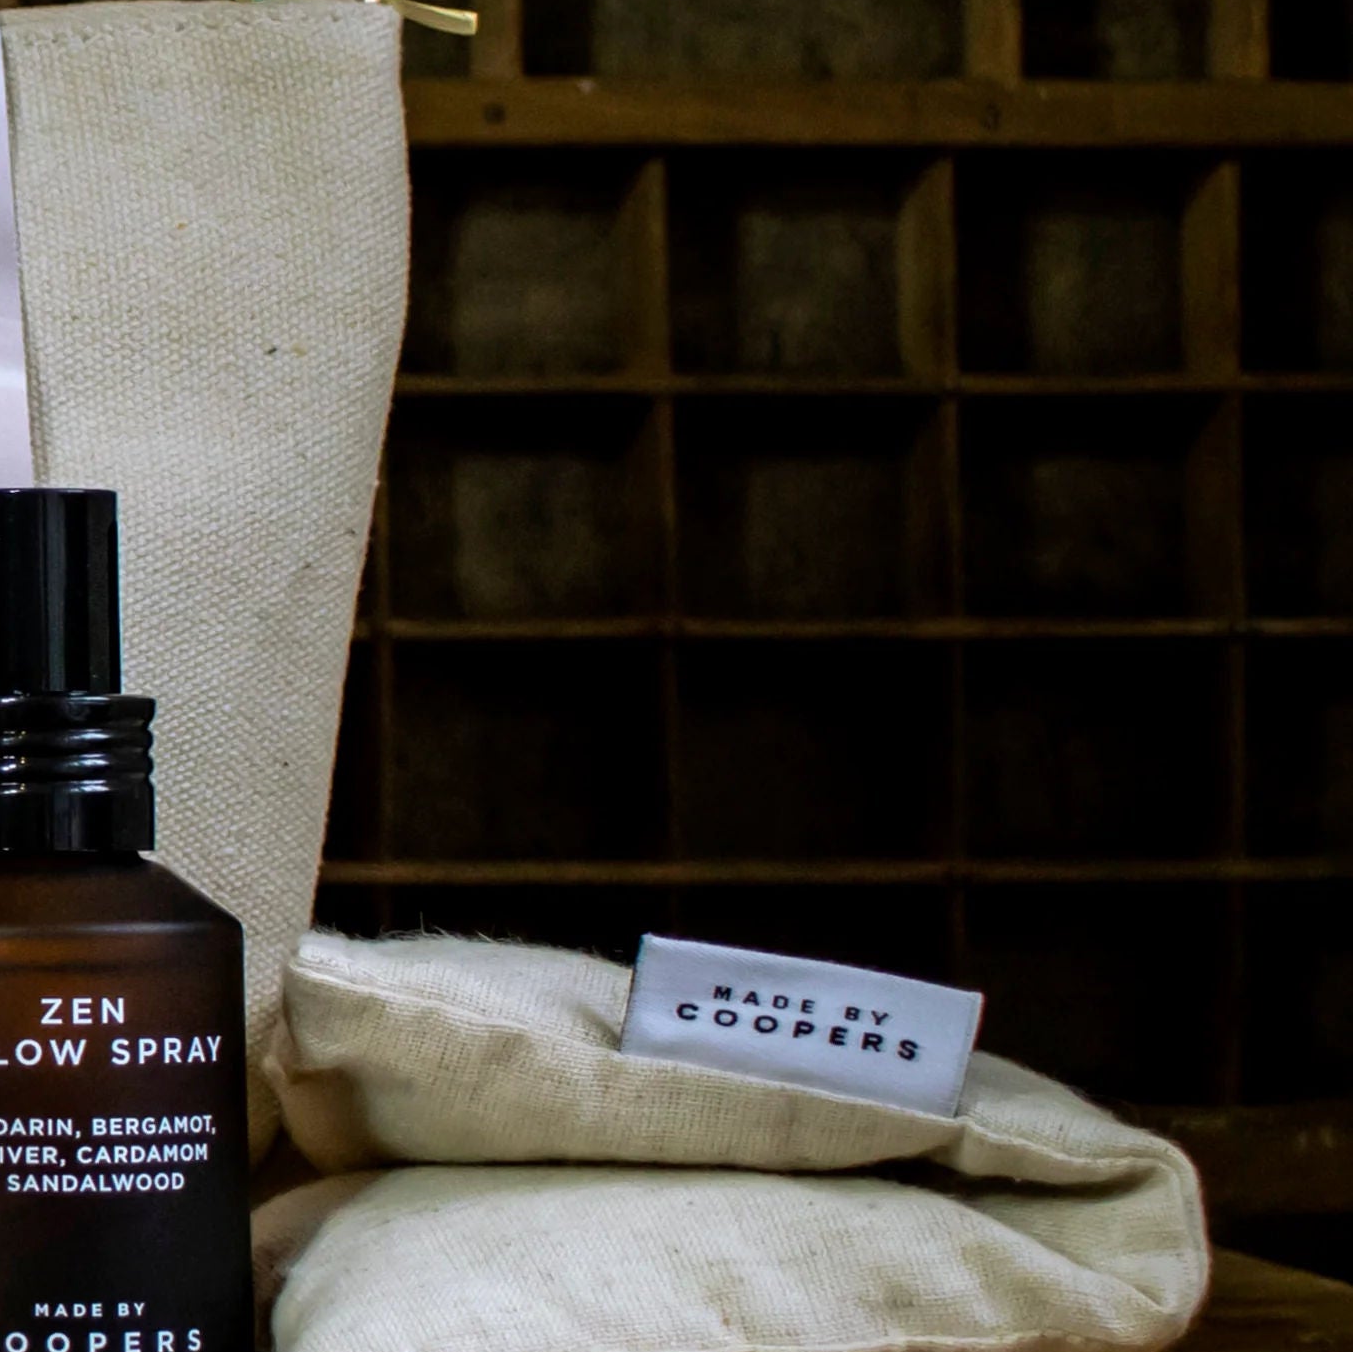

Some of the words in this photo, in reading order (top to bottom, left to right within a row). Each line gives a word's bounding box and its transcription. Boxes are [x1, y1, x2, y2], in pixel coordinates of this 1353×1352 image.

[40, 997, 125, 1025] ZEN
[712, 985, 817, 1015] MADE
[844, 1005, 891, 1026] BY
[675, 1002, 922, 1062] COOPERS
[110, 1035, 222, 1065] SPRAY
[92, 1114, 217, 1136] BERGAMOT,
[76, 1143, 209, 1164] CARDAMOM
[7, 1172, 186, 1193] SANDALWOOD
[34, 1302, 104, 1318] MADE
[117, 1302, 146, 1318] BY
